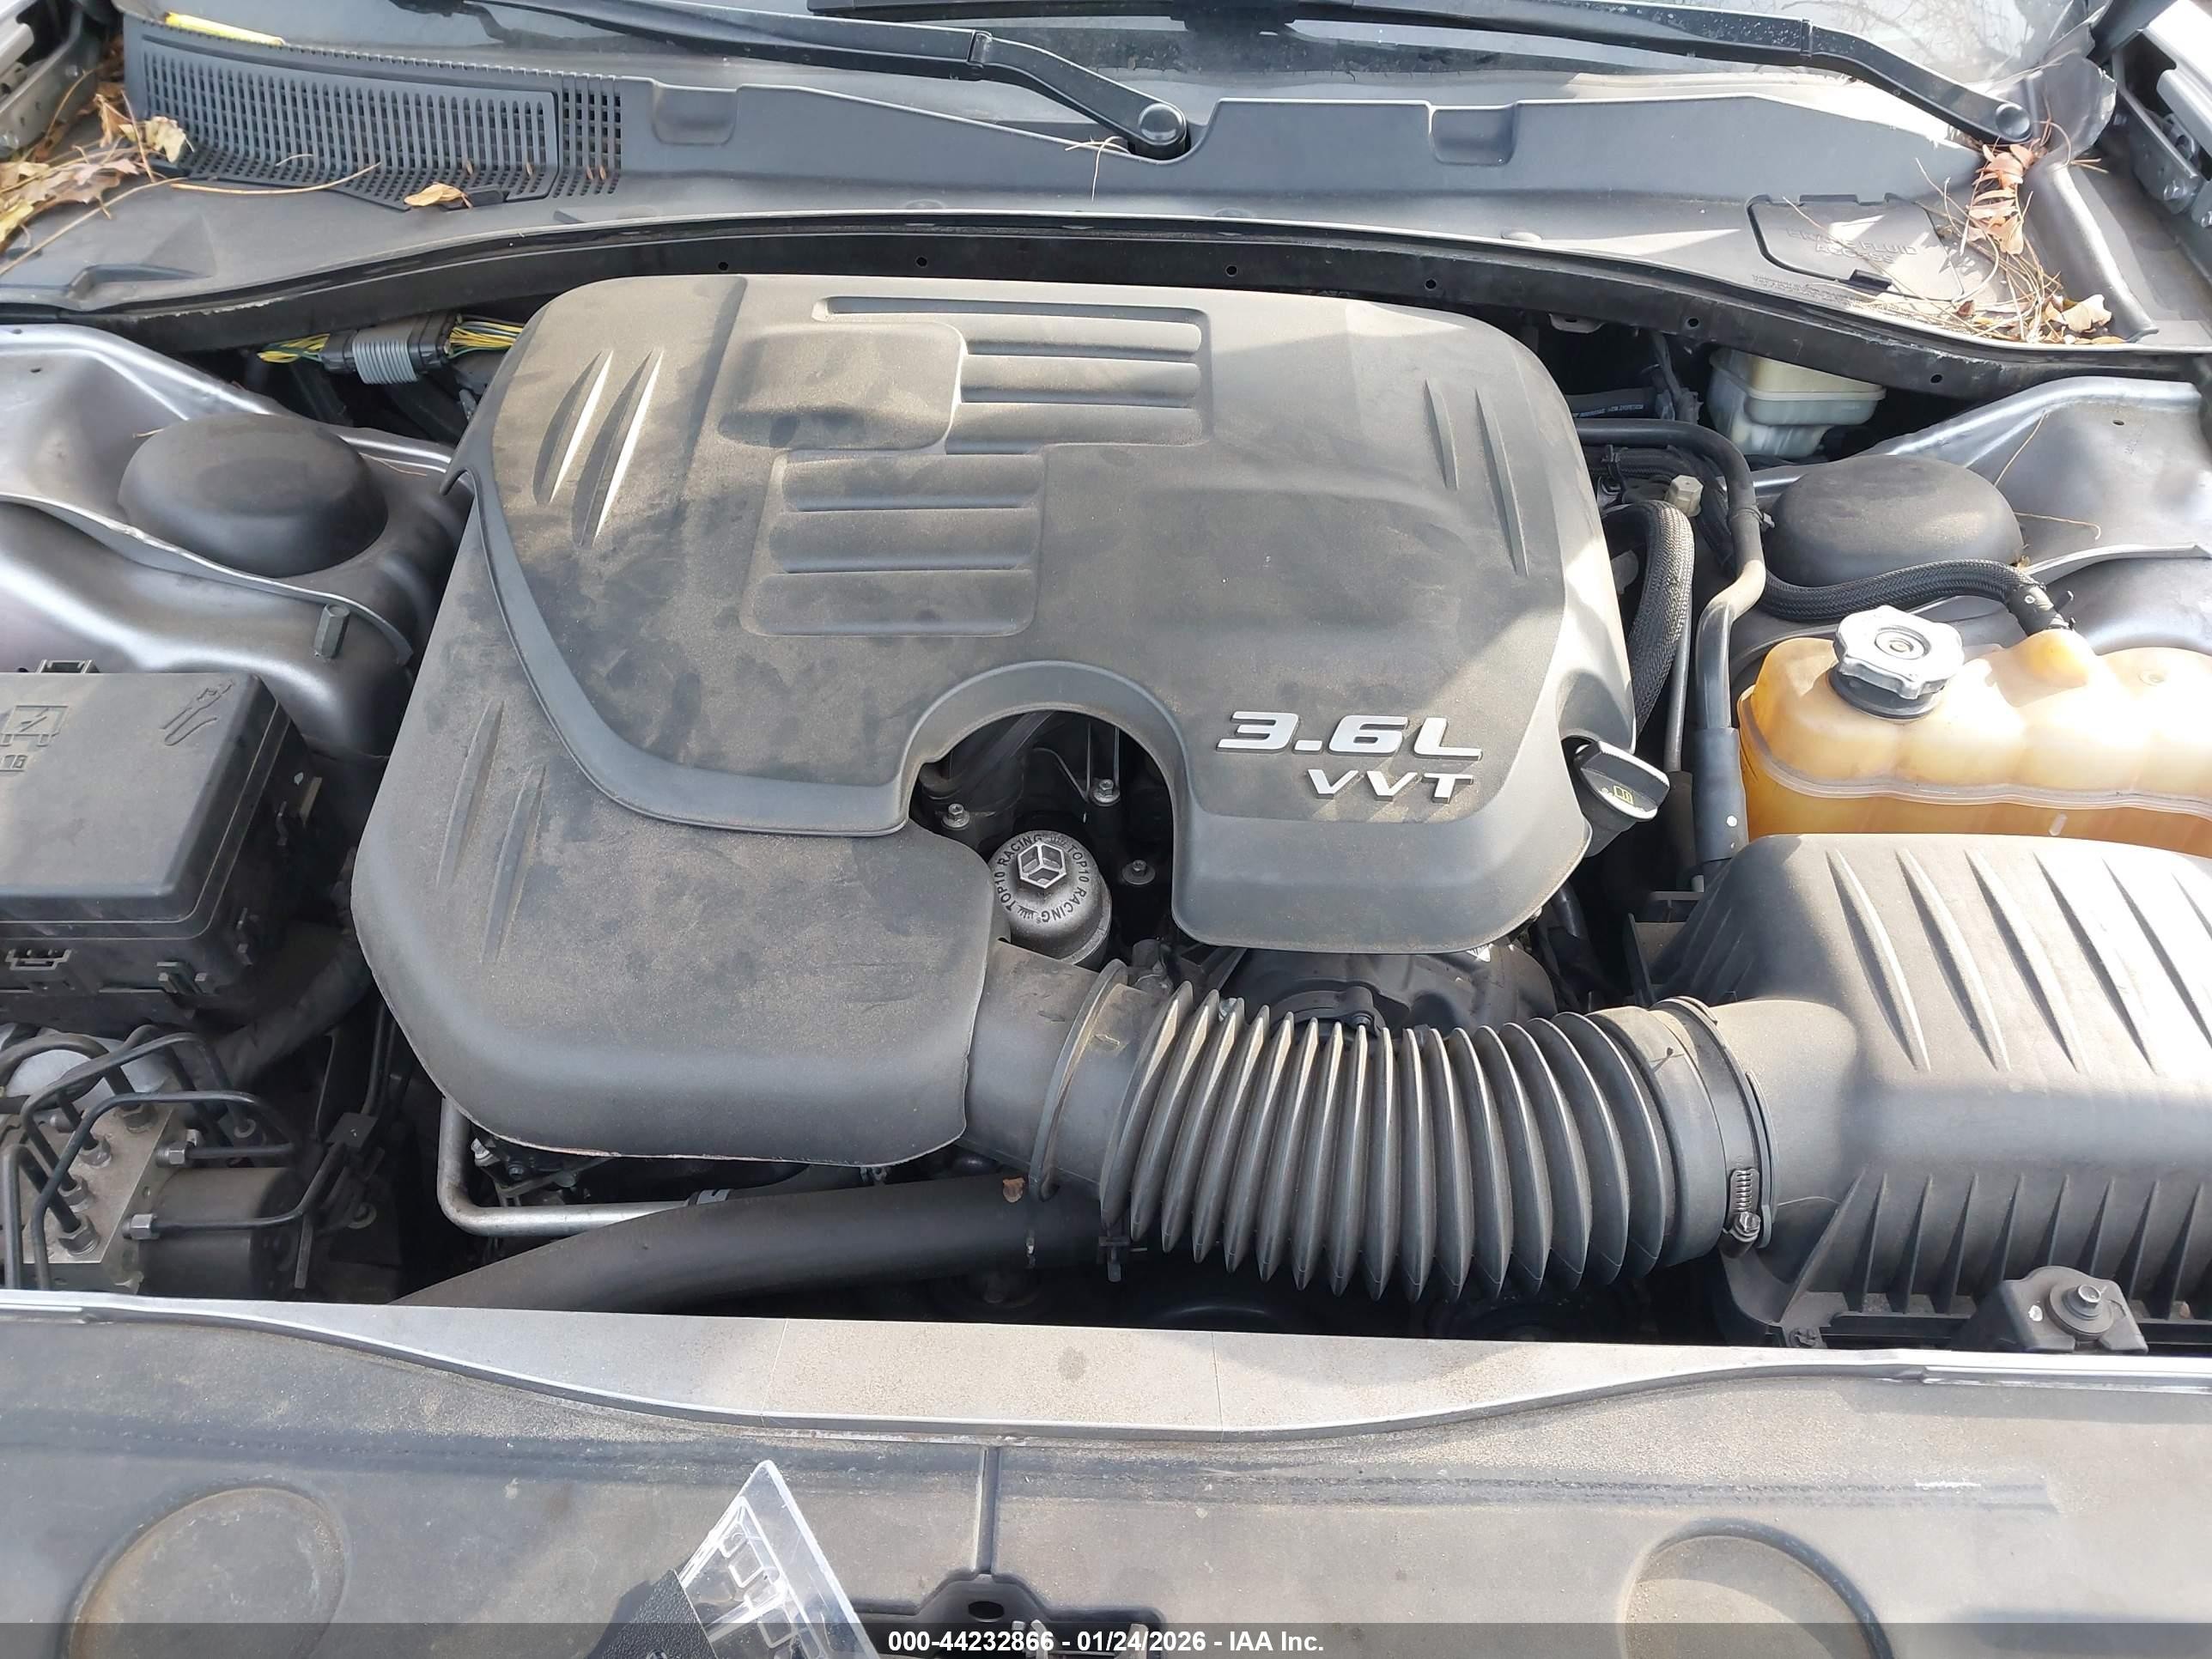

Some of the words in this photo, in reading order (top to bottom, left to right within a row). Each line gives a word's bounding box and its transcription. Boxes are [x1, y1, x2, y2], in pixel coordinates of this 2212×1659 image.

[1860, 240, 1918, 256] FLUID
[1216, 711, 1483, 762] 3.6L
[1305, 769, 1474, 804] VVT
[996, 834, 1042, 866] RACING
